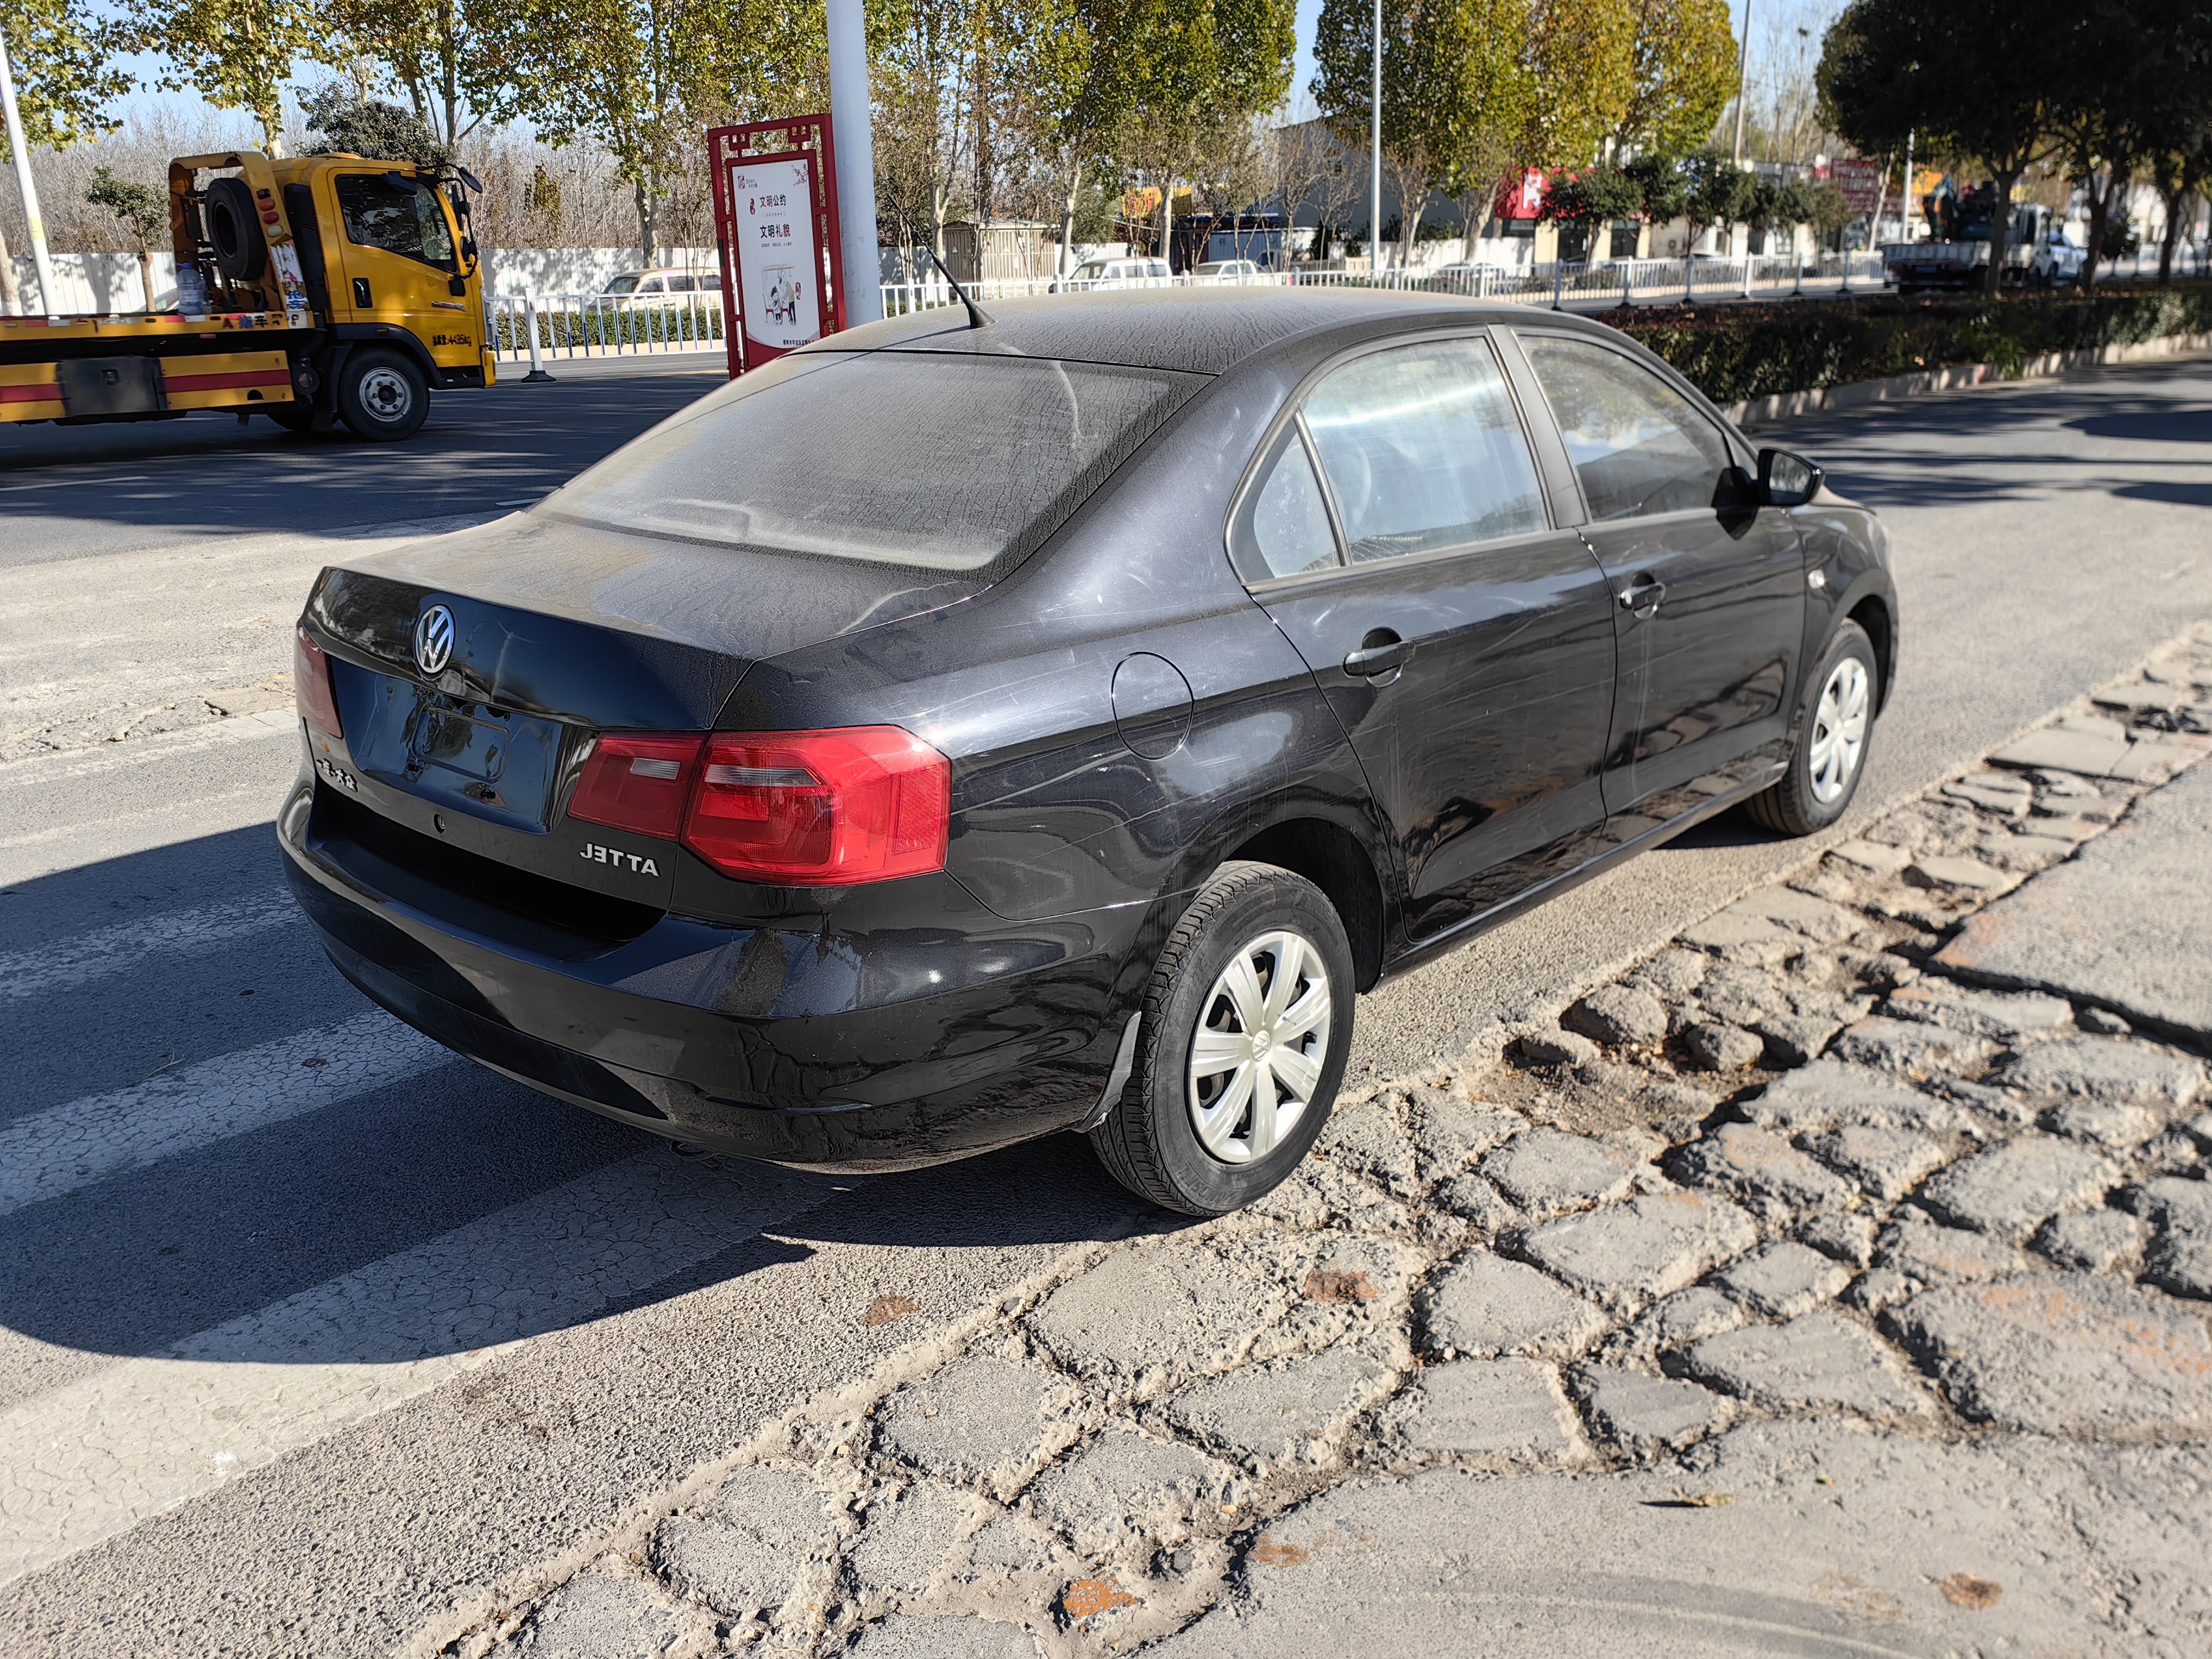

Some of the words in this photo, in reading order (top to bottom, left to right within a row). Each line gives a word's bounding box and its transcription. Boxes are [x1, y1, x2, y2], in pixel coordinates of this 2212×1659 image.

[759, 194, 786, 208] 文明公约
[759, 223, 791, 238] 文明礼貌
[579, 842, 661, 877] JETTA
